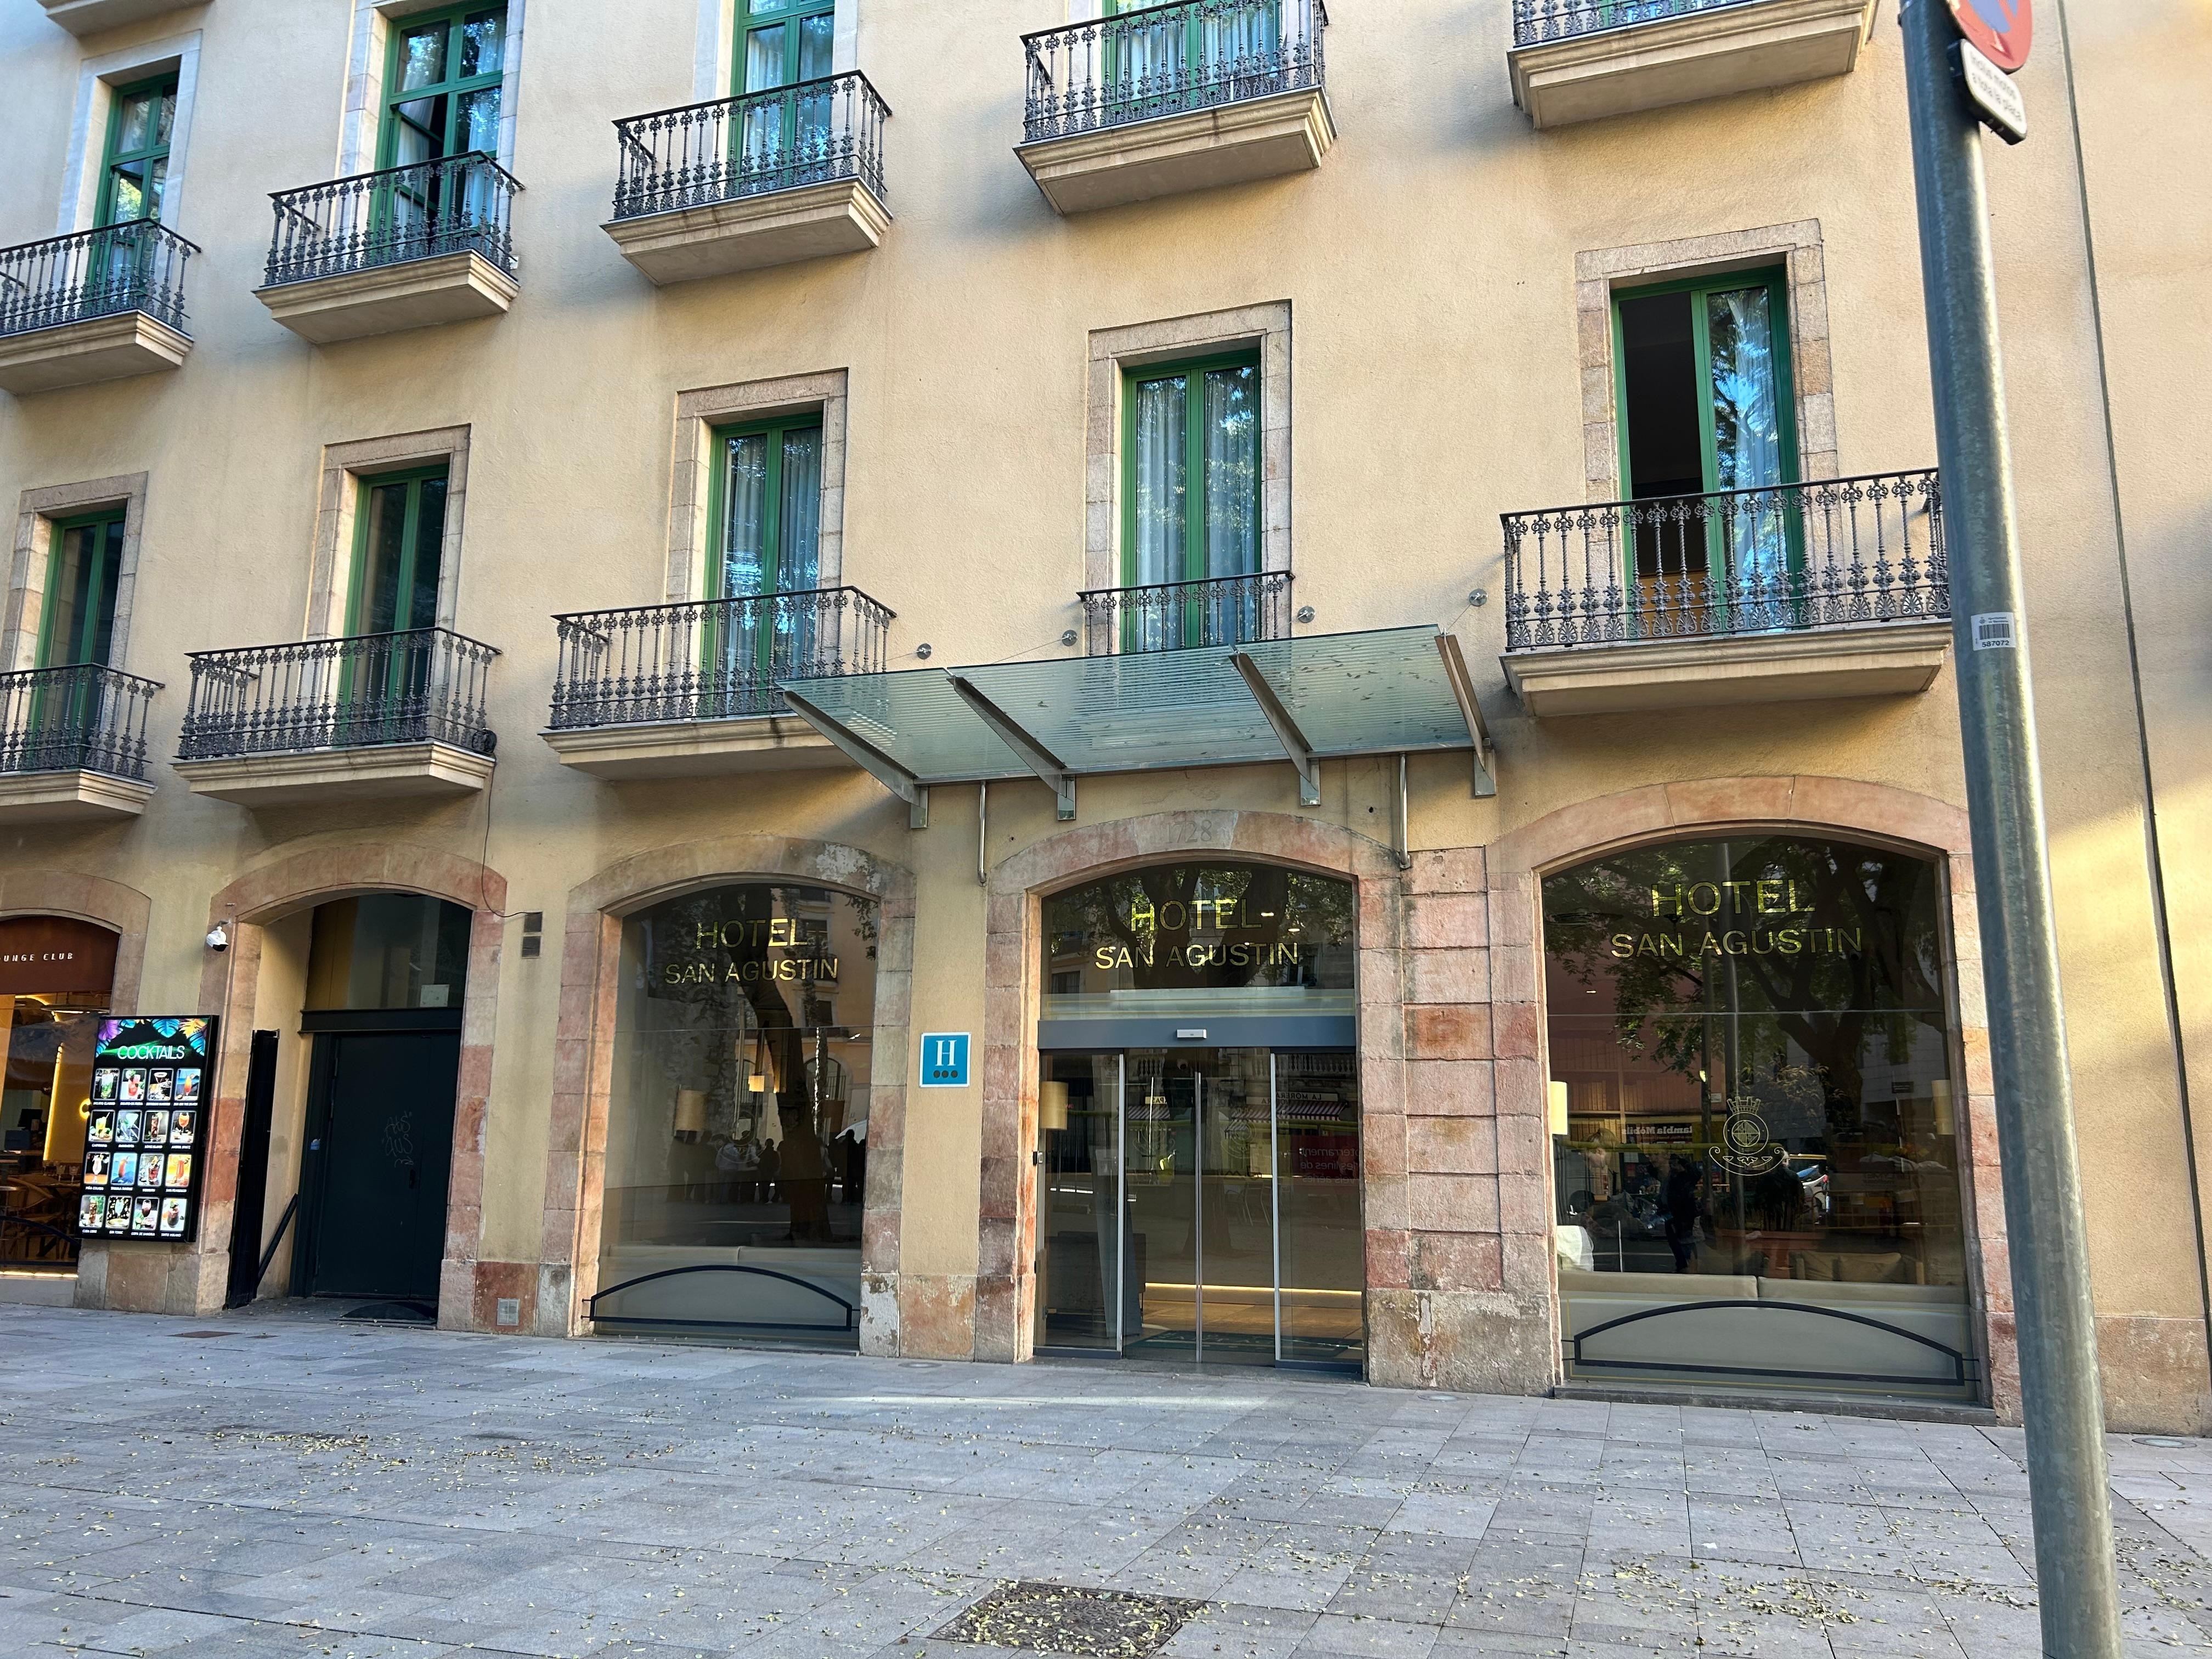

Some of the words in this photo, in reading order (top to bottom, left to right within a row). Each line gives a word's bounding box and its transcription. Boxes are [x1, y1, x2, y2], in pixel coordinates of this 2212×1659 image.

[1651, 879, 1816, 917] HOTEL
[1131, 899, 1262, 932] HOTEL
[696, 918, 808, 950] HOTEL
[1611, 933, 1683, 958] SAN
[1699, 927, 1862, 956] AGUSTIN
[43, 952, 73, 961] CLUB
[1094, 945, 1153, 969] SAN
[1165, 942, 1297, 968] AGUSTIN
[664, 962, 715, 985] SAN
[725, 958, 838, 983] AGUSTIN
[117, 1045, 185, 1060] COCKTAILS
[935, 1040, 957, 1066] H
